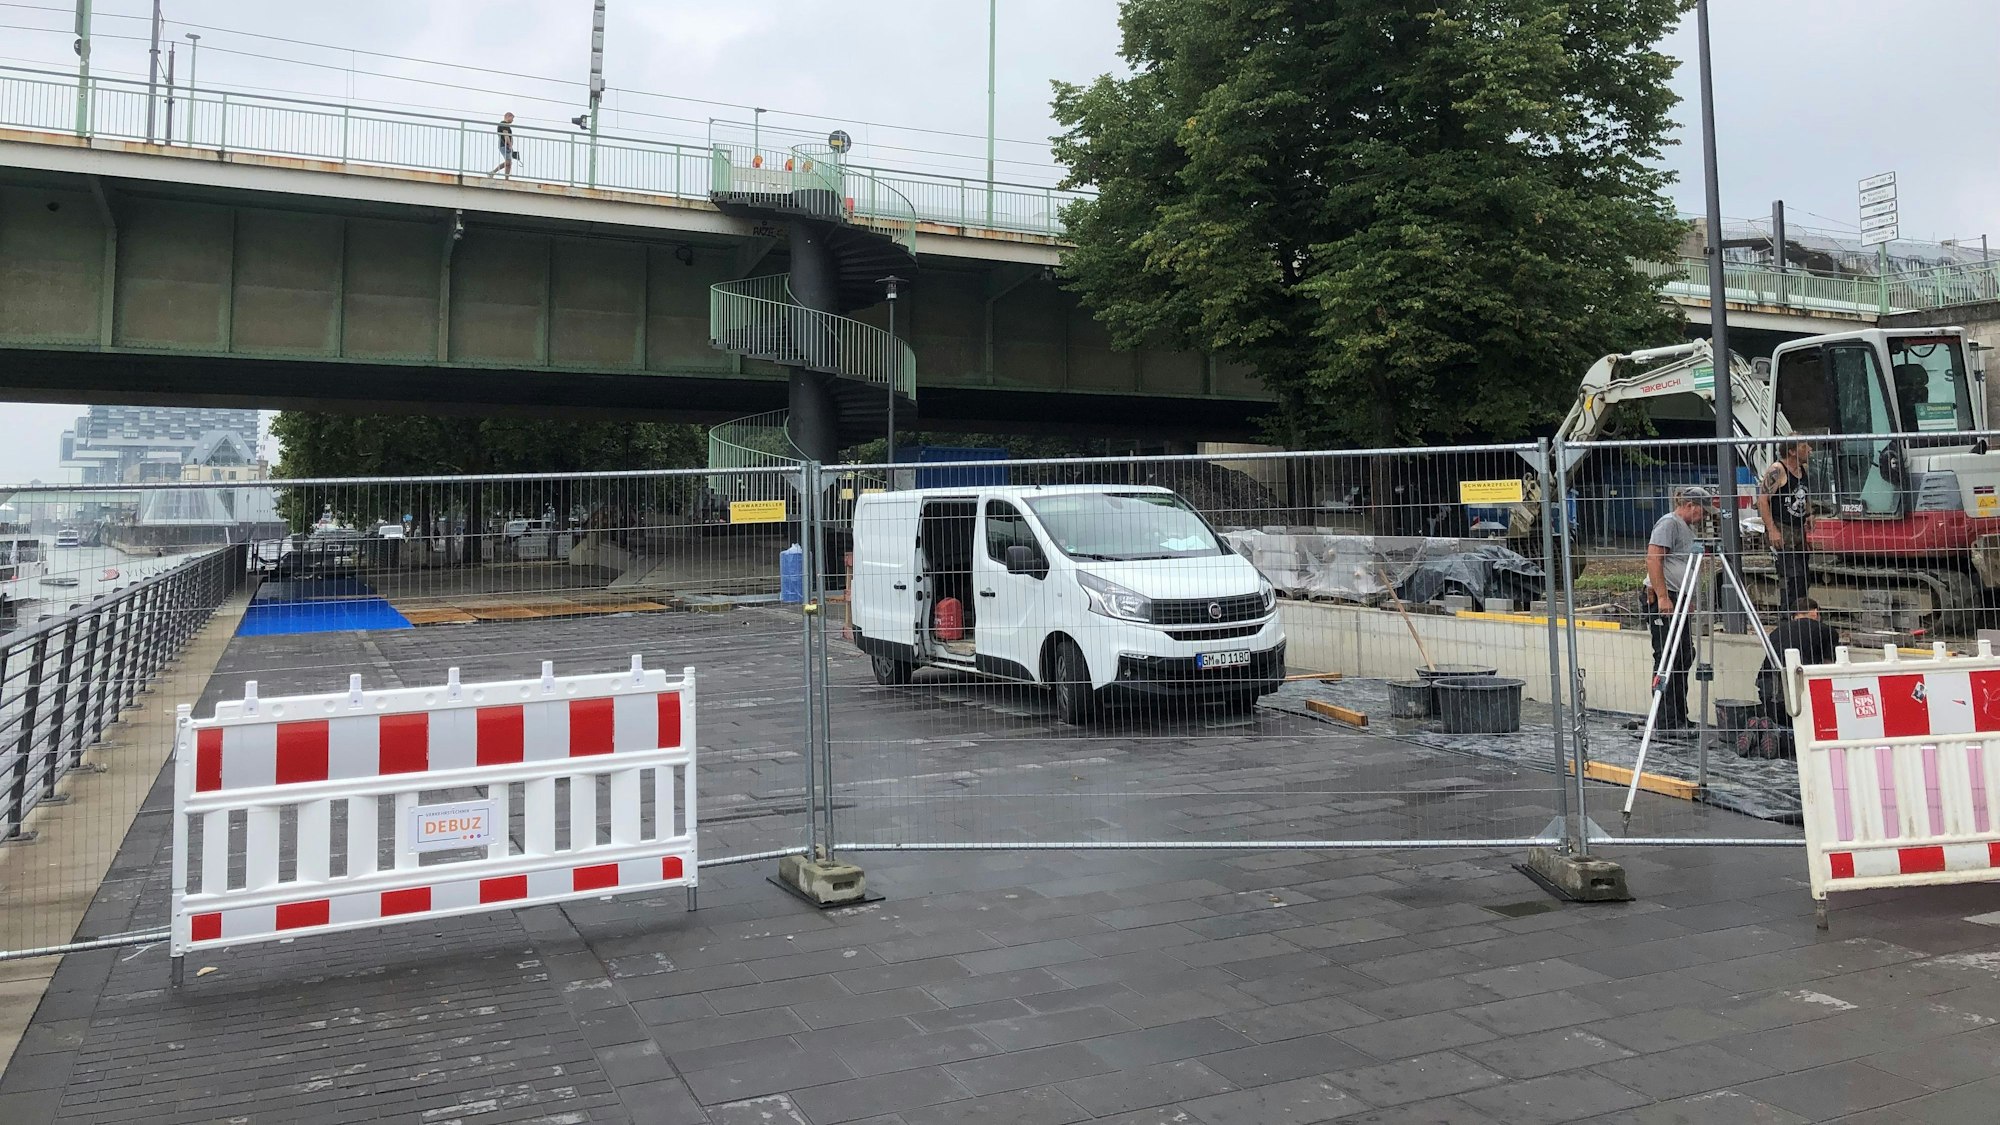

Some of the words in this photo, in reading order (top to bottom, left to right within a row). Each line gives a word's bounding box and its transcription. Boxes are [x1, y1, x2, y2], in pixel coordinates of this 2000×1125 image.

[1640, 378, 1681, 394] TAKEUCHI
[1841, 504, 1863, 512] TB250
[1202, 655, 1215, 666] GM
[1220, 653, 1226, 664] D
[1854, 696, 1874, 707] SPS
[425, 816, 482, 834] DEBUZ
